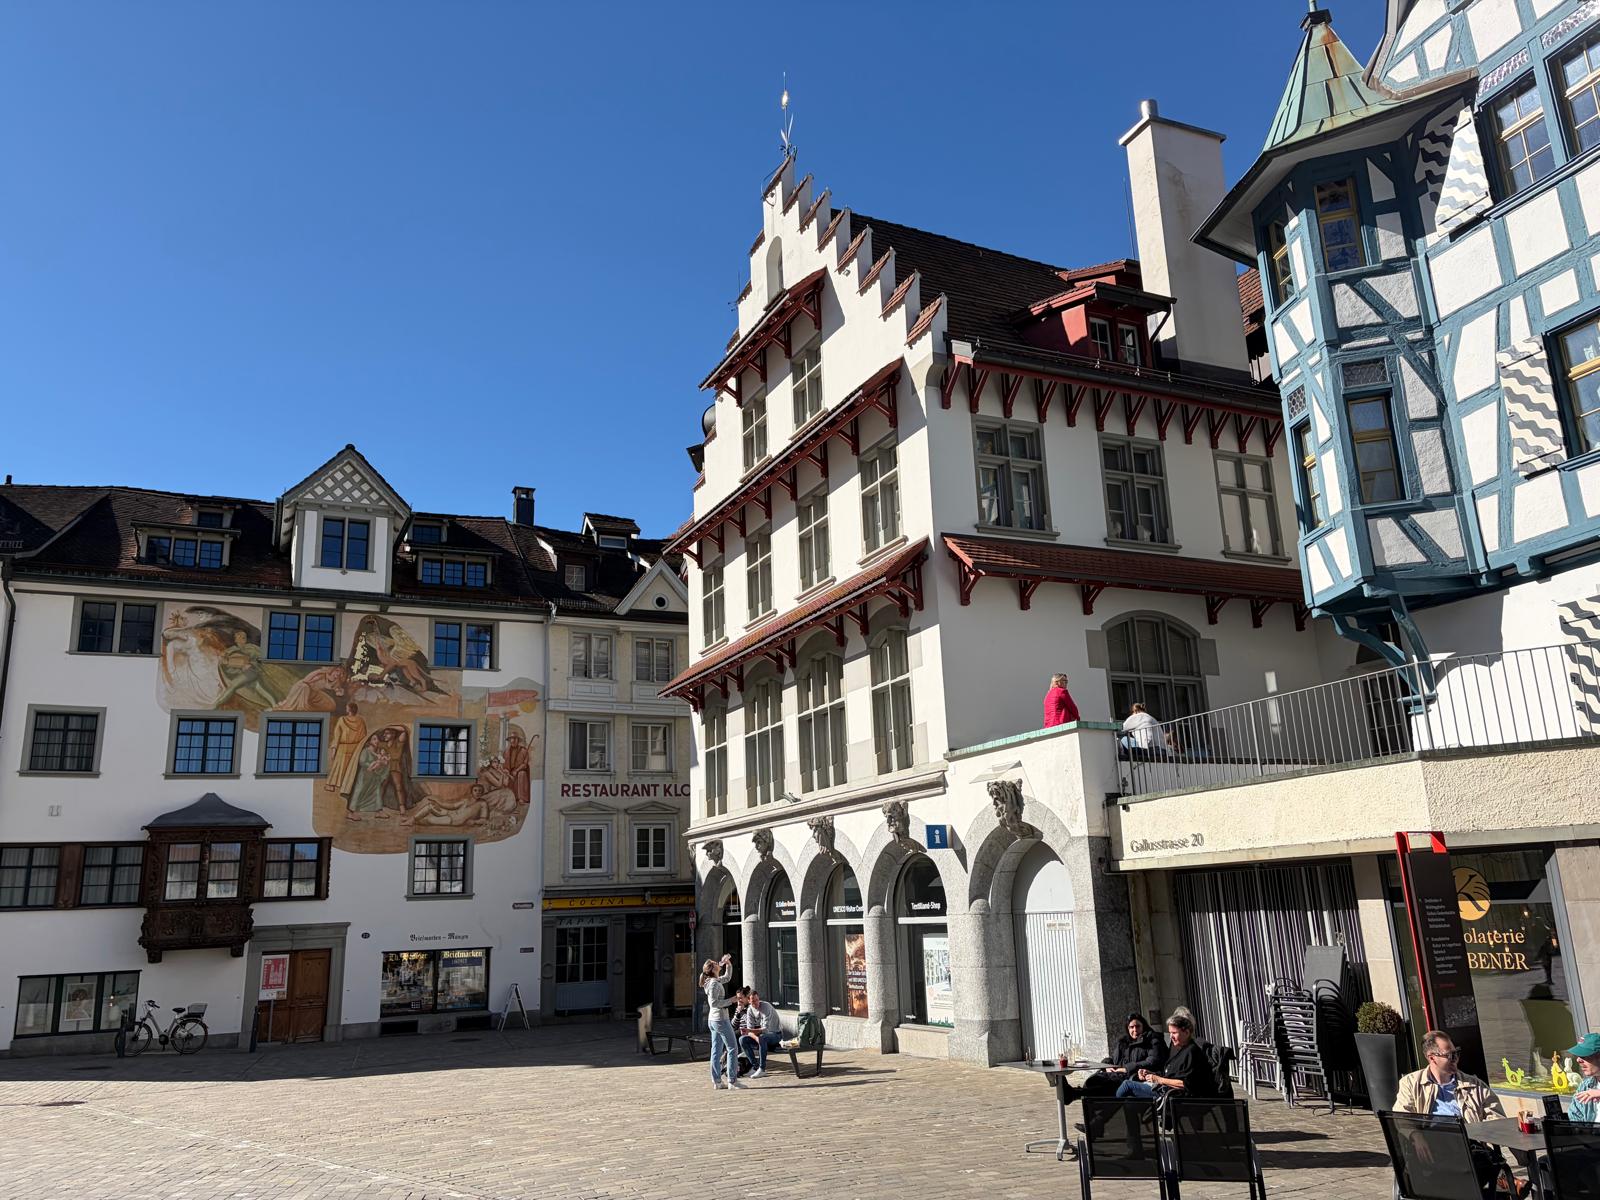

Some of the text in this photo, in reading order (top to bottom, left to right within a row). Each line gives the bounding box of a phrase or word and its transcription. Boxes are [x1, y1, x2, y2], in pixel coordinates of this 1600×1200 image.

[561, 784, 659, 797] RESTAURANT
[1130, 833, 1204, 852] Gallusstrasse 20
[569, 899, 625, 907] COCINA
[558, 918, 608, 927] TAPAS
[1467, 952, 1530, 970] BENER
